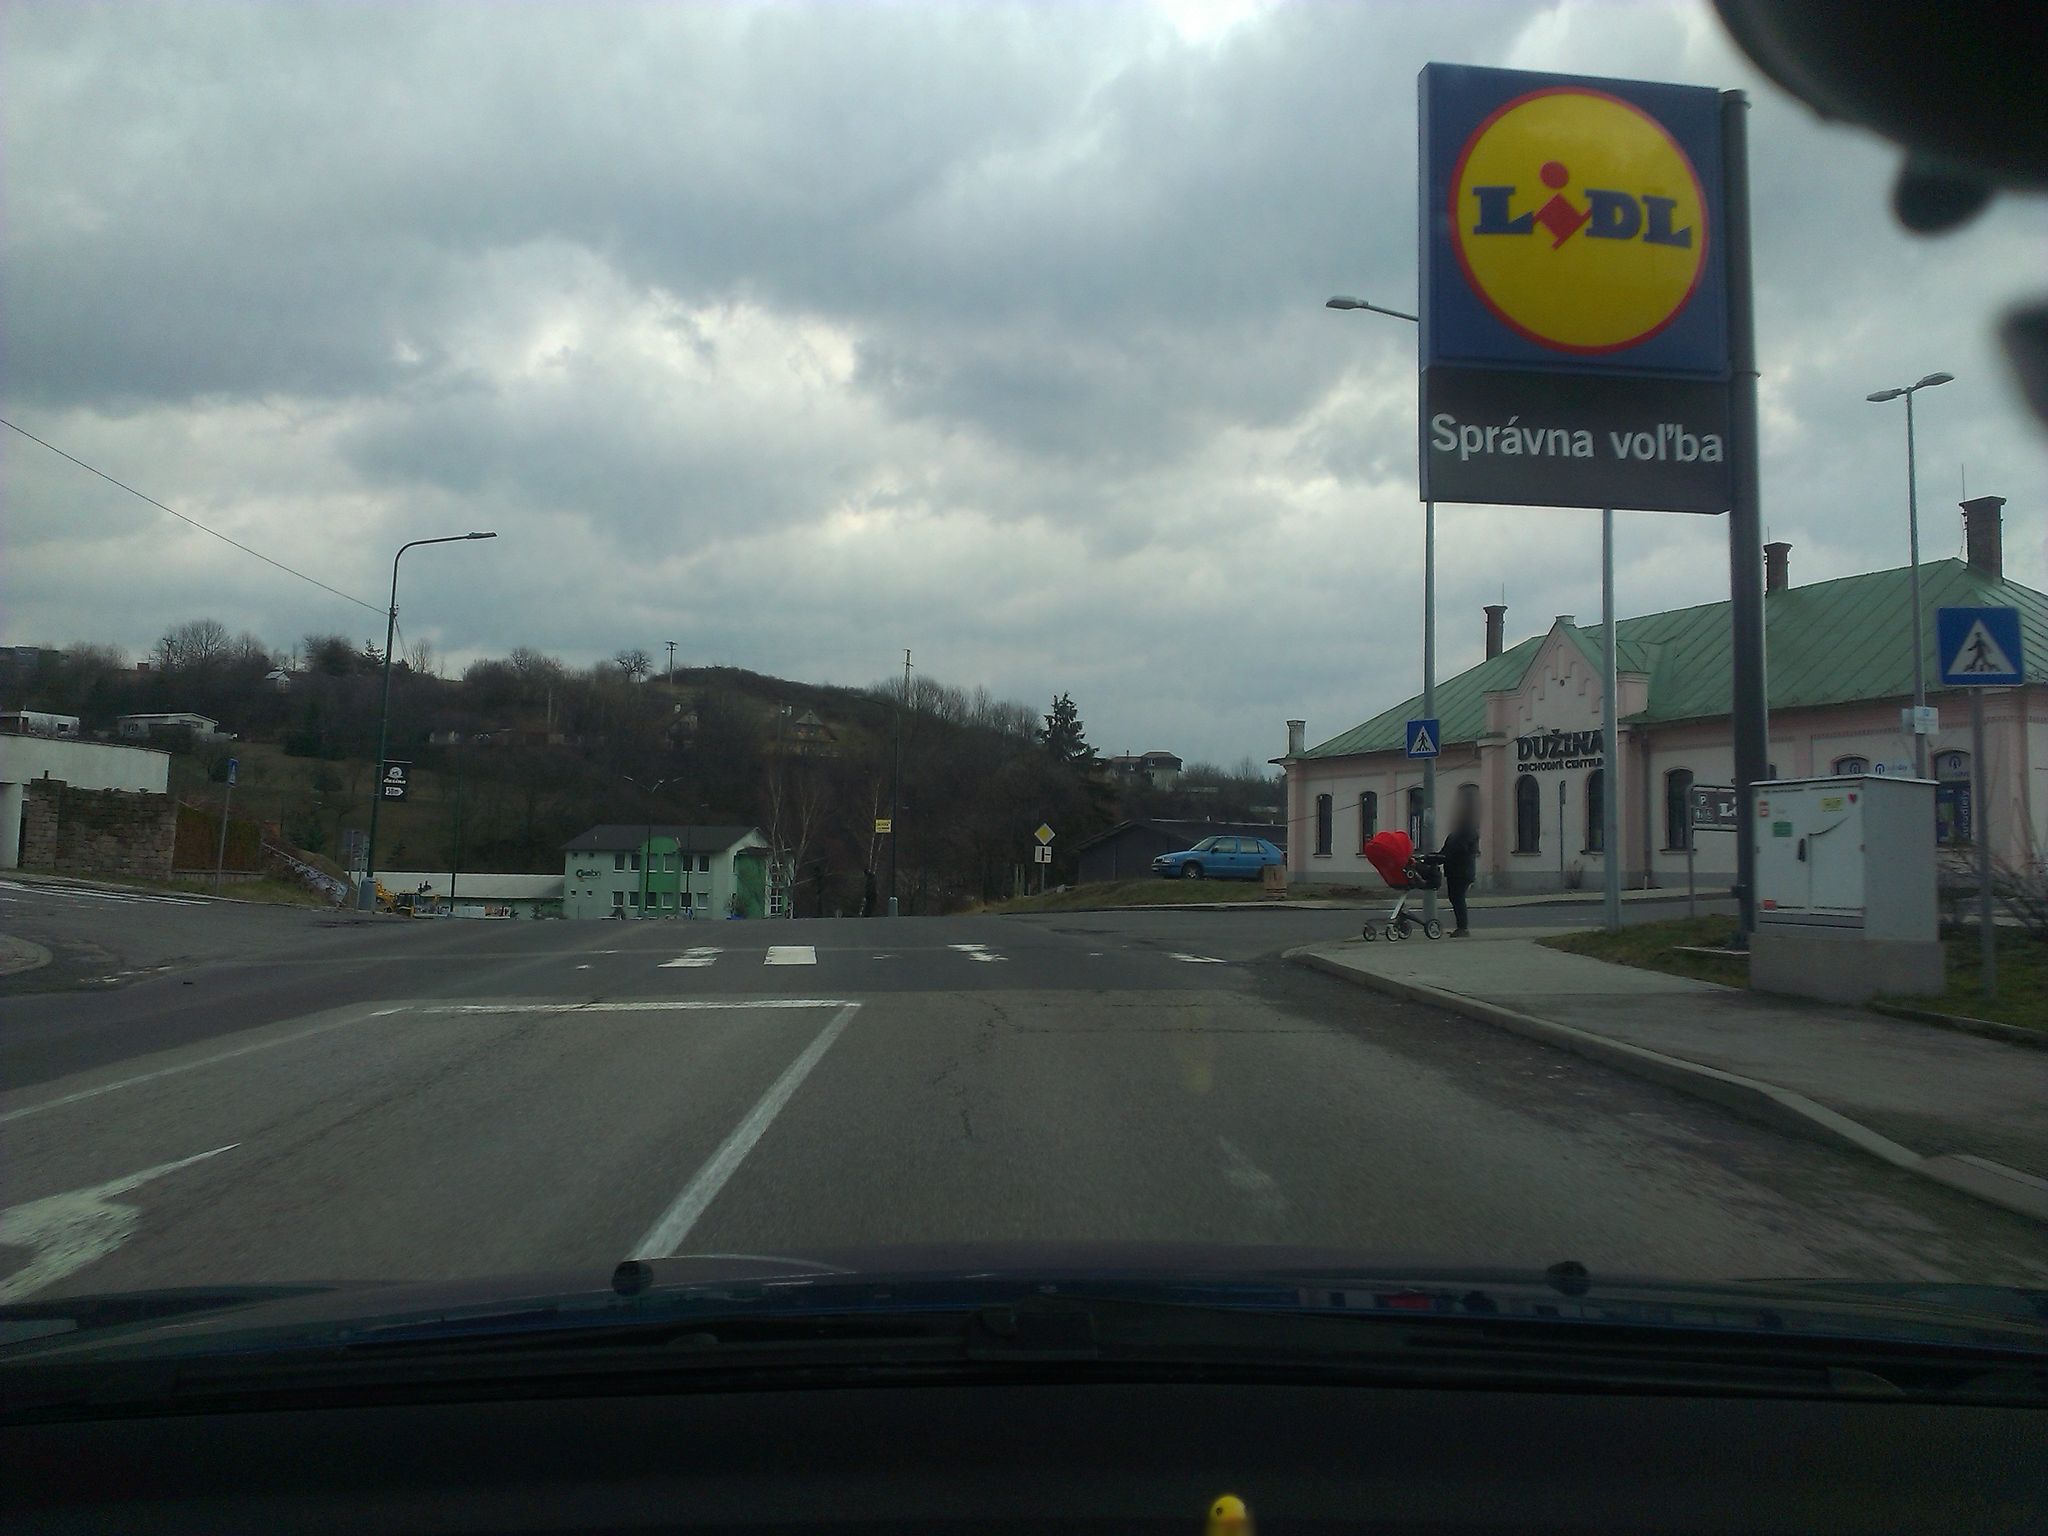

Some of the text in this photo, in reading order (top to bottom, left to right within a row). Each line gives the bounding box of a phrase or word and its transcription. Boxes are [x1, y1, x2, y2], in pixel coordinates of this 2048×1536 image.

[1431, 412, 1724, 463] Správna voľba
[1516, 728, 1604, 760] DUŽINA
[1565, 757, 1603, 770] CENTRU
